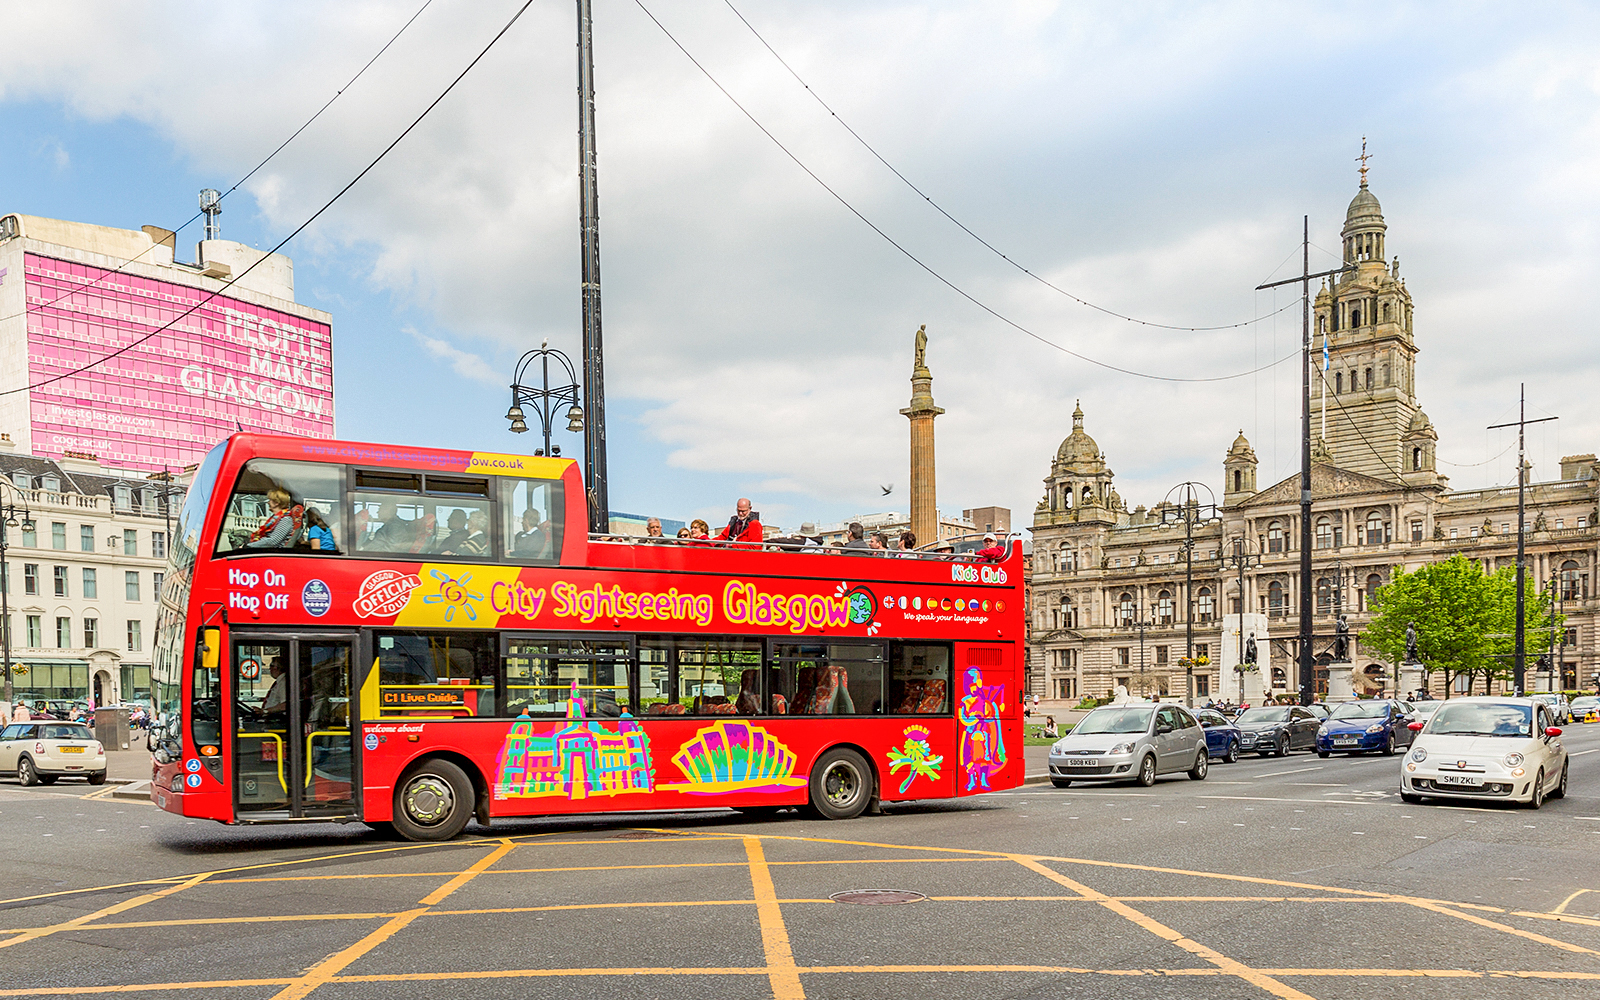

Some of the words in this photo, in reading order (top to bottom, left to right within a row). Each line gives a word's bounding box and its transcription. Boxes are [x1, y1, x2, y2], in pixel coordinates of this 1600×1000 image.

[223, 307, 324, 361] PEOPLE
[248, 346, 324, 388] MAKE
[180, 364, 325, 420] GLASGOW
[51, 404, 155, 428] investglasgow.com
[52, 434, 112, 451] cogc.ac.uk
[301, 443, 524, 470] www.citysightseeingglasgow.co.uk
[228, 568, 260, 587] Hop
[263, 569, 286, 587] On
[365, 572, 394, 590] GLASGOW
[952, 564, 979, 582] Kids
[981, 566, 1007, 584] Club
[228, 592, 260, 611] Hop
[263, 593, 289, 611] Off
[360, 577, 419, 612] OFFICIAL
[382, 595, 408, 613] TOUR
[490, 580, 546, 620] City
[551, 580, 713, 626] Sightseeing
[723, 580, 850, 633] Glasgow
[903, 612, 915, 620] We
[915, 613, 936, 623] speak
[936, 615, 953, 623] your
[953, 613, 989, 625] language
[384, 693, 398, 703] C1
[400, 693, 426, 703] Live
[427, 693, 458, 703] Guide
[364, 724, 396, 733] welcome
[397, 723, 426, 732] aboard
[1460, 776, 1476, 785] ZKL
